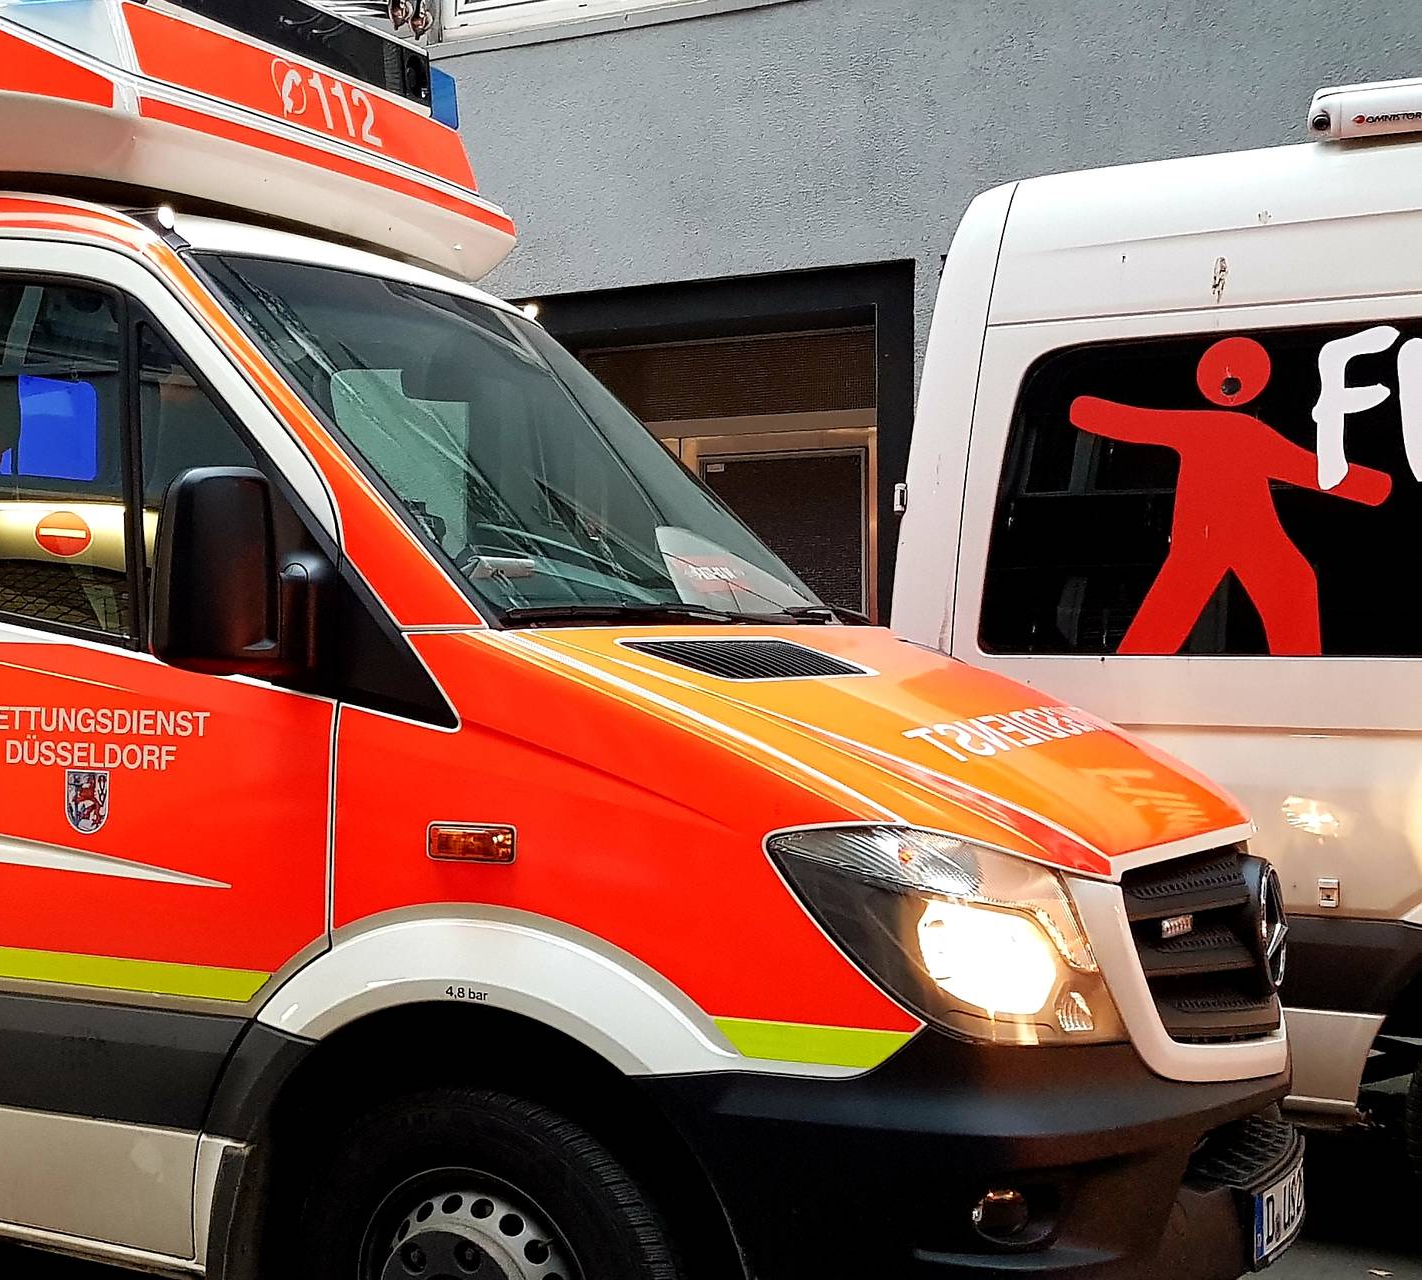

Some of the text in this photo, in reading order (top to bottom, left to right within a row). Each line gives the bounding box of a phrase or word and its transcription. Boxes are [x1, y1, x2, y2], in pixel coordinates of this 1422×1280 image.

[308, 71, 383, 147] 112
[5, 734, 177, 771] DÜSSELDORF
[445, 985, 489, 1001] 4,8 bar
[1266, 1194, 1275, 1246] D
